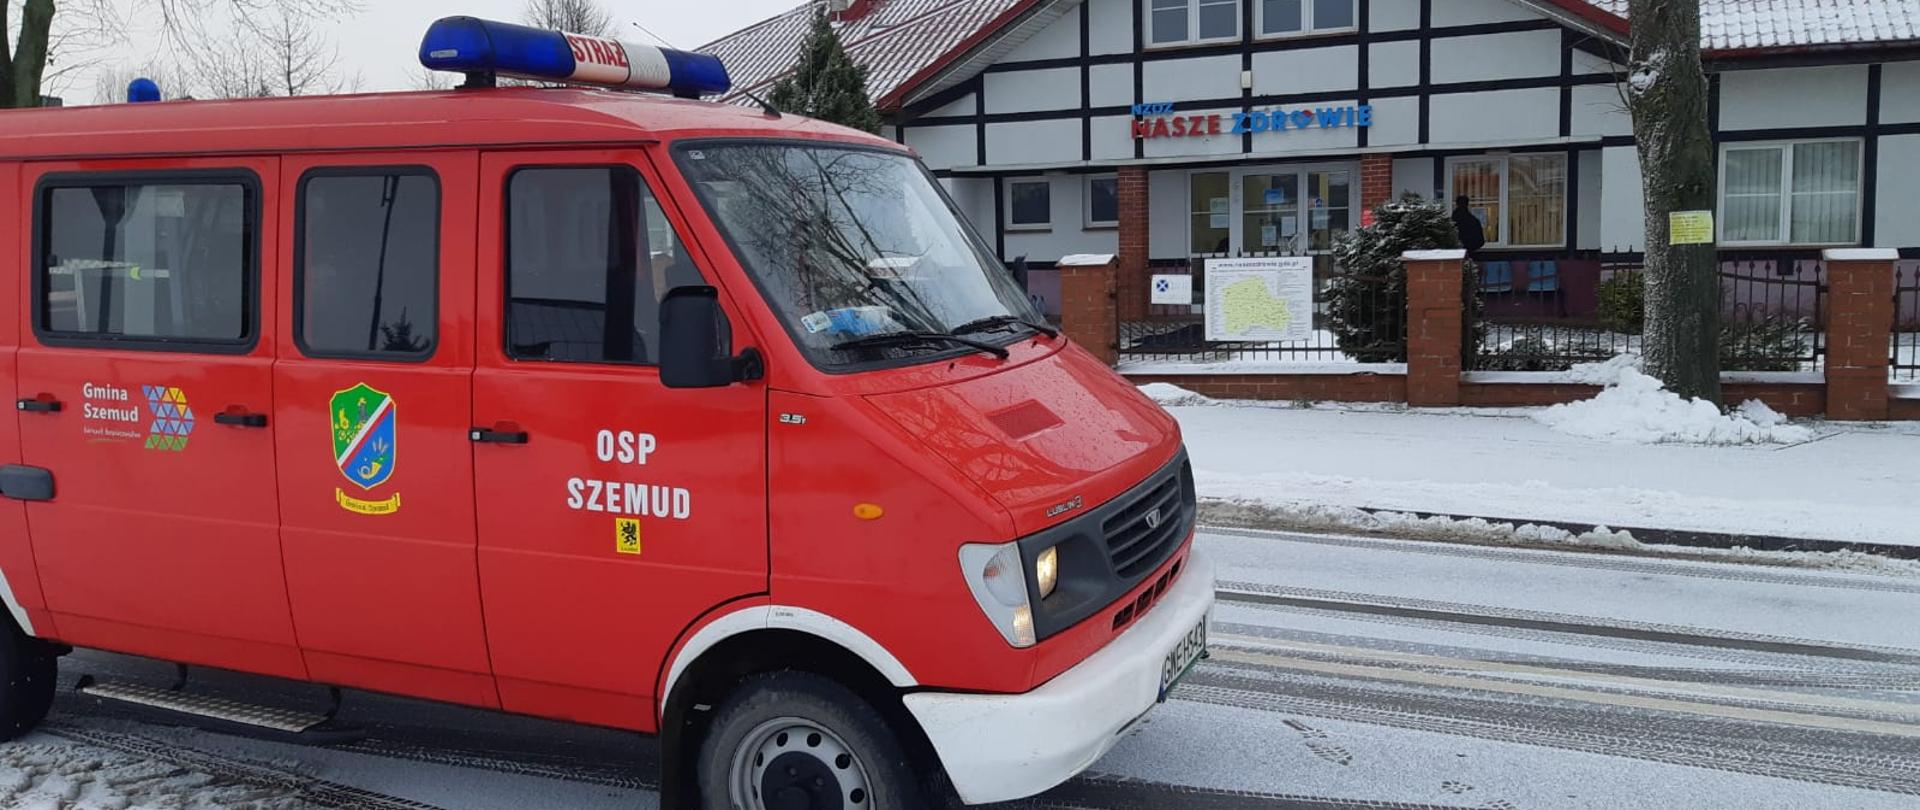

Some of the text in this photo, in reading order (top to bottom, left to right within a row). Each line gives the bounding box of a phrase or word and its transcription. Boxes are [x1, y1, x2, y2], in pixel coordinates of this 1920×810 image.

[1131, 103, 1174, 116] NZOZ
[1131, 114, 1221, 139] NASZE
[83, 382, 128, 401] Gmina
[83, 403, 139, 422] Szemud
[597, 429, 657, 465] OSP
[567, 477, 691, 519] SZEMUD
